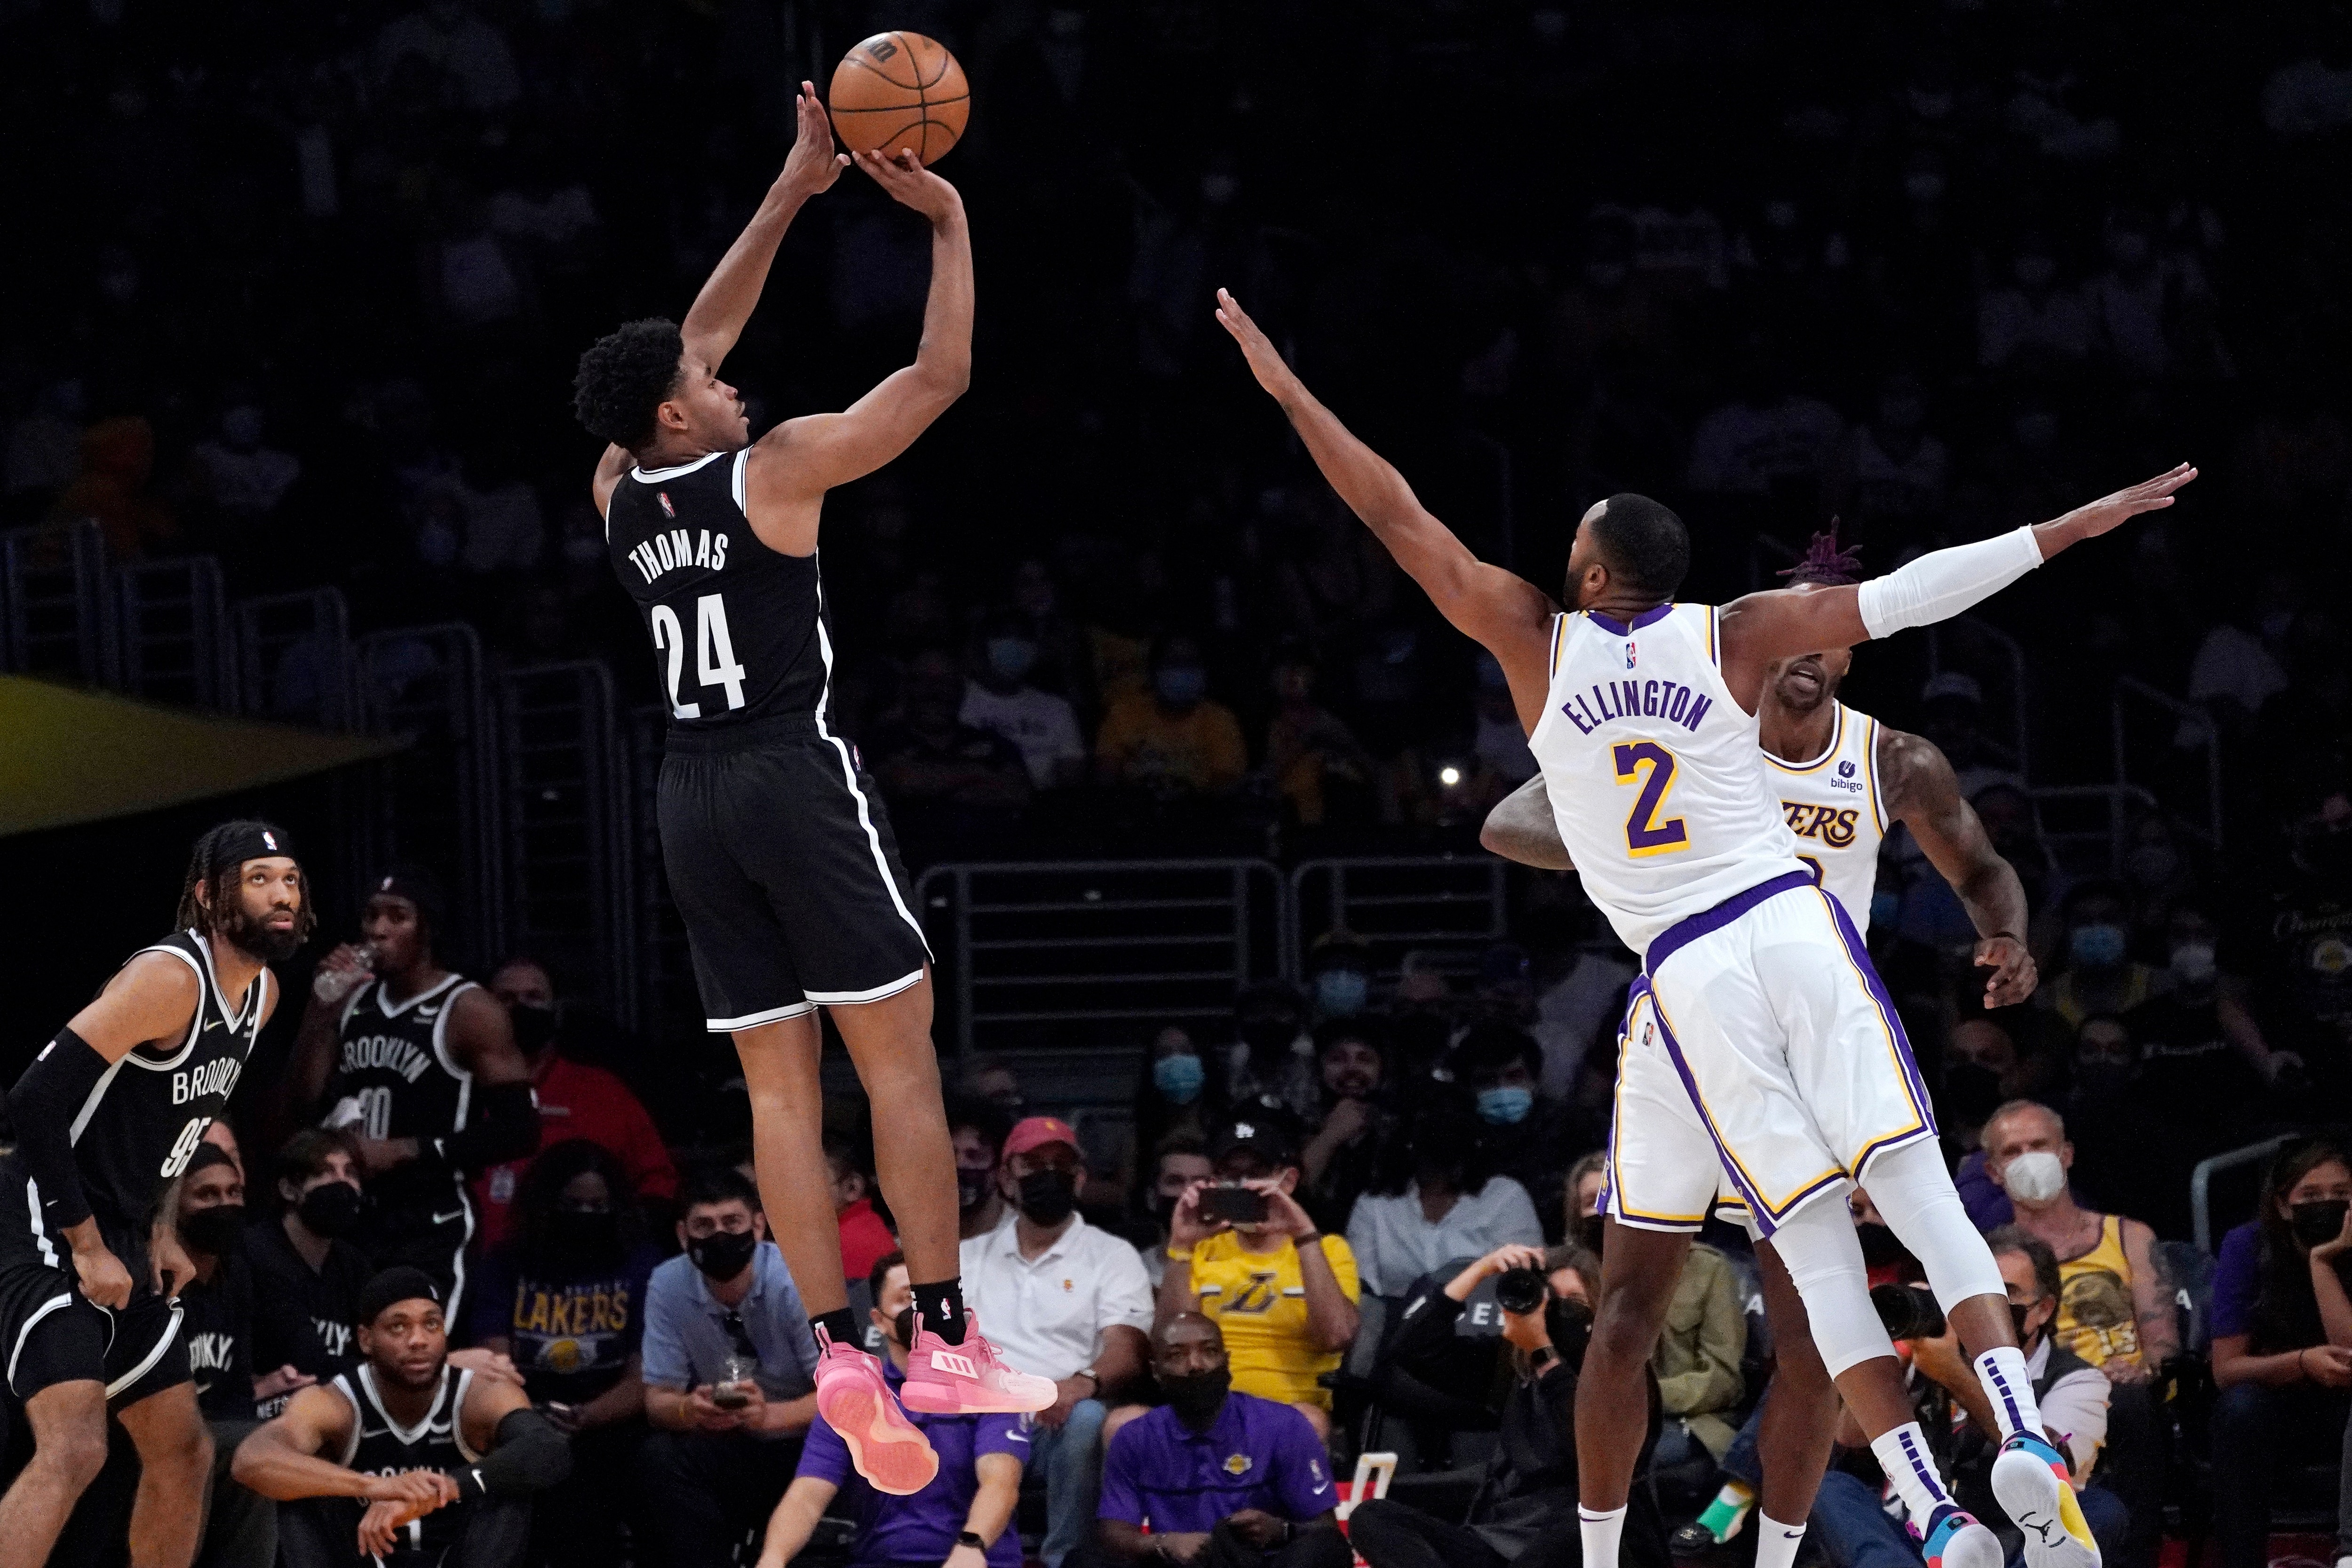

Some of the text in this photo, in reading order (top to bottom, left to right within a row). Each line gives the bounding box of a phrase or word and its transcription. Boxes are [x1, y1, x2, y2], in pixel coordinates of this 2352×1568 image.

[628, 529, 728, 585] THOMAS
[652, 593, 746, 719] 24
[1561, 680, 1713, 735] ELLINGTON
[1610, 739, 1691, 859] 2
[1830, 778, 1863, 793] bibigo
[160, 1116, 212, 1178] 95
[513, 1286, 629, 1335] LAKERS
